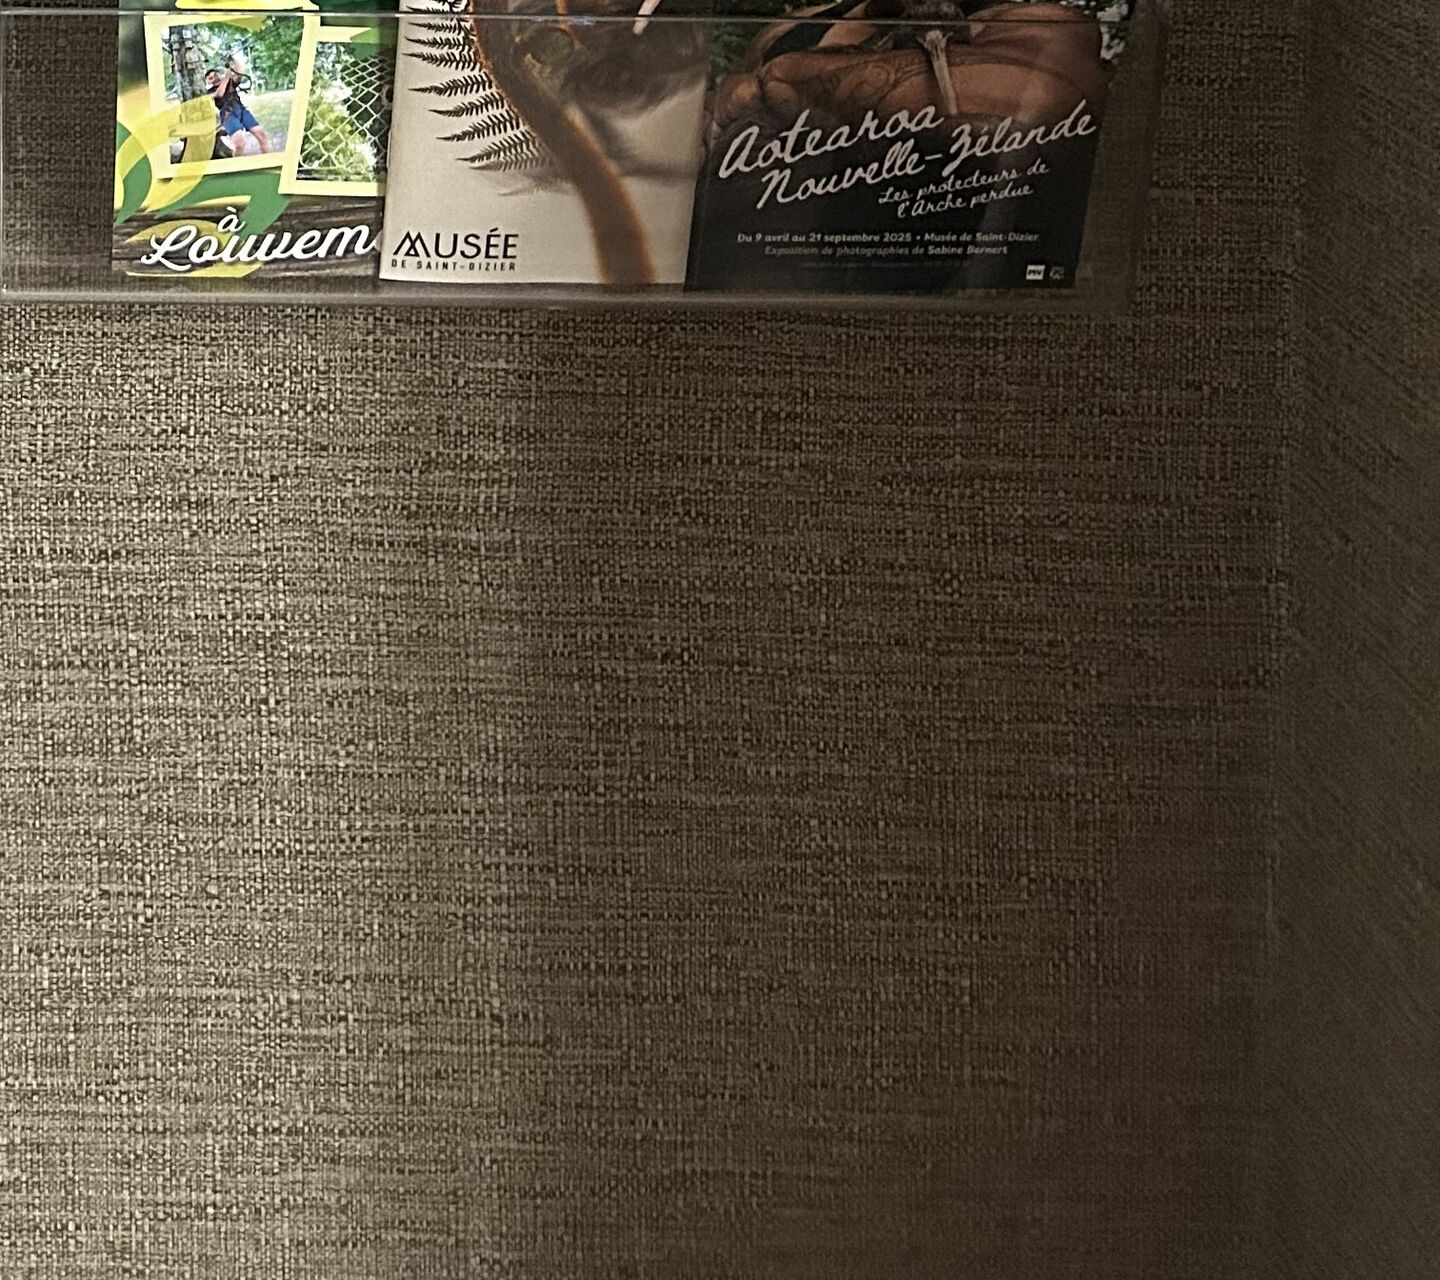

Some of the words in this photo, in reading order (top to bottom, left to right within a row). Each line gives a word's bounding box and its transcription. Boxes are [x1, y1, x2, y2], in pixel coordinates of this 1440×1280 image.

[718, 104, 945, 179] Aotearoa
[756, 99, 1098, 210] Nouvelle-Zélande
[878, 186, 913, 205] Les
[916, 167, 1019, 202] protecteurs
[1026, 158, 1051, 179] de
[218, 206, 246, 232] à
[897, 195, 965, 219] l'Arche
[970, 183, 1033, 210] perdue
[393, 227, 519, 259] MUSÉE
[391, 258, 406, 269] DE
[417, 260, 516, 271] SAINT-DIZIER
